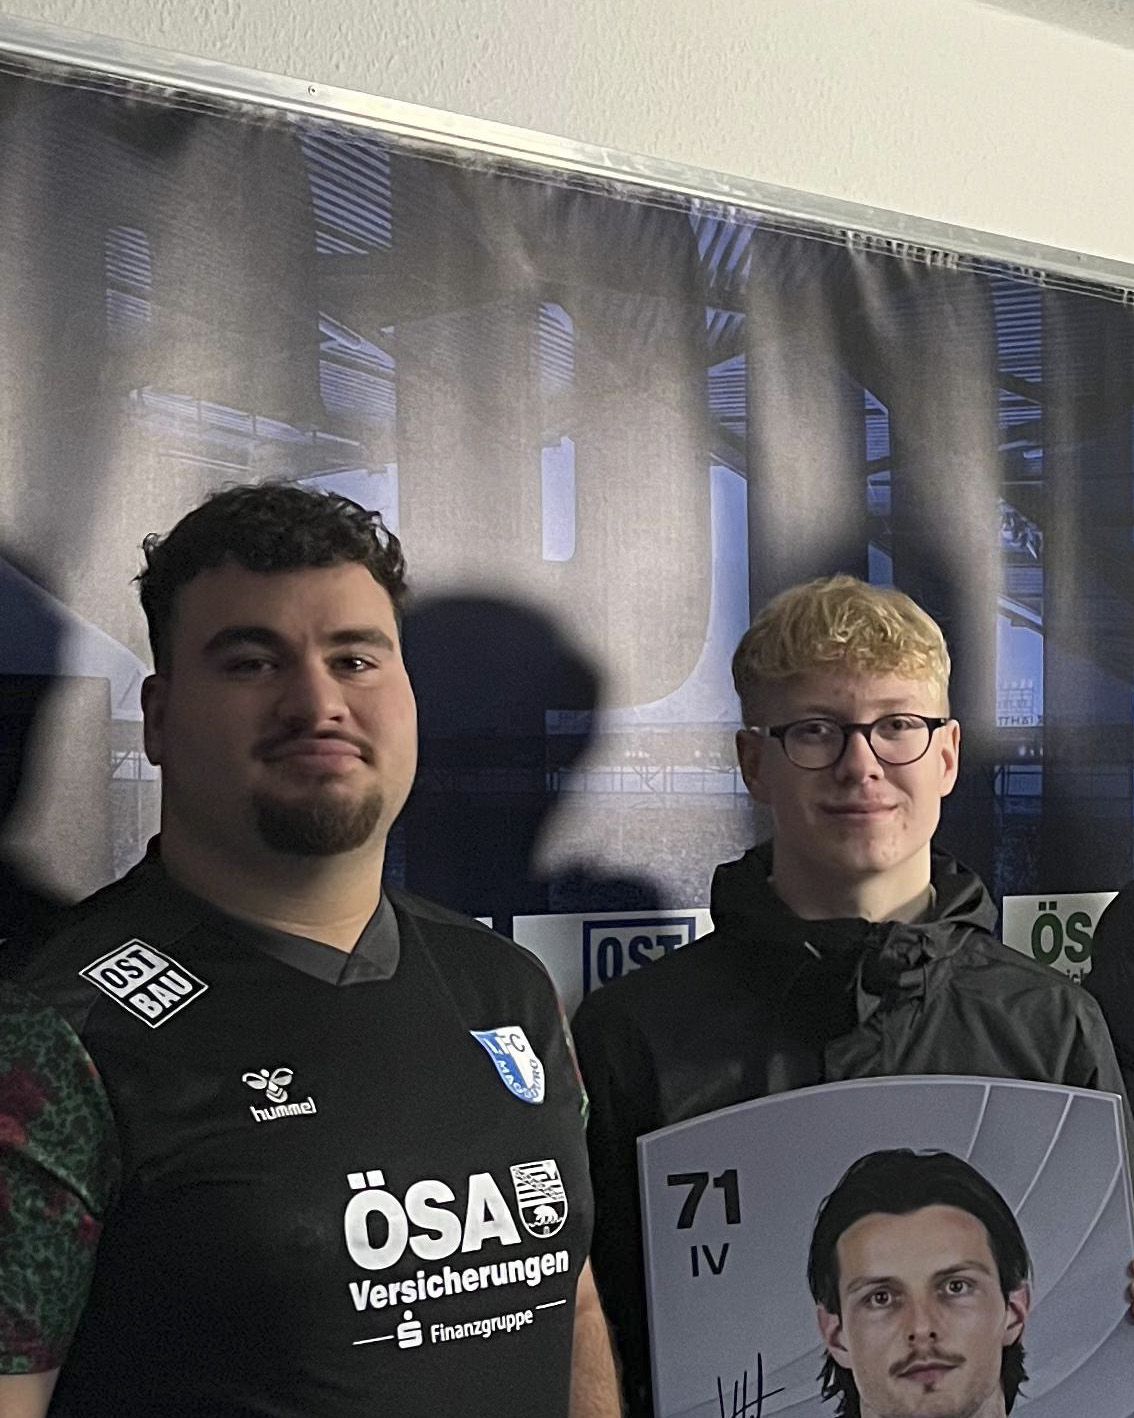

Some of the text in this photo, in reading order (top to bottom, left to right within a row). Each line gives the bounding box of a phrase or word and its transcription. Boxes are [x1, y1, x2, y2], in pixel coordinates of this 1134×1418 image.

[100, 949, 156, 989] OST
[129, 969, 193, 1019] BAU
[249, 1096, 317, 1122] hummel
[344, 1169, 522, 1271] ÖSA
[667, 1169, 741, 1229] 71
[349, 1250, 569, 1311] Versicherungen
[691, 1243, 730, 1277] IV
[431, 1309, 534, 1344] Finanzgruppe
